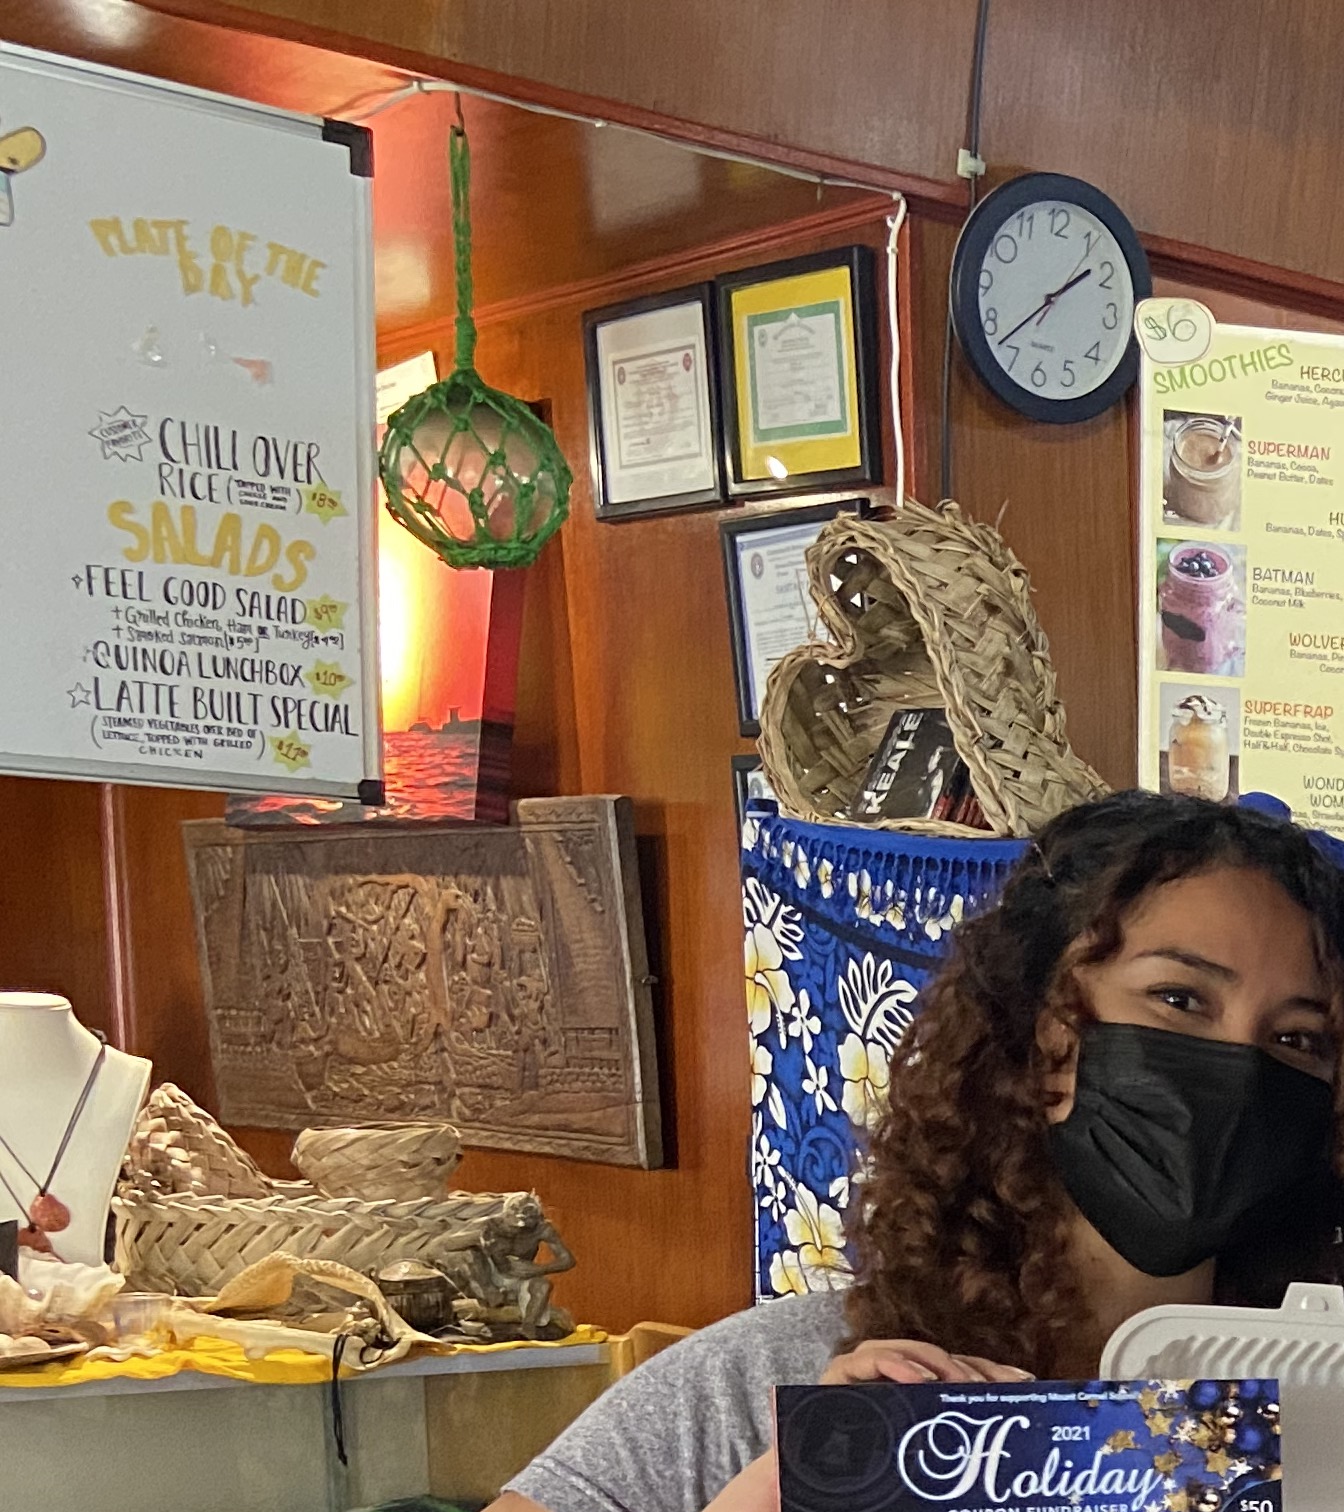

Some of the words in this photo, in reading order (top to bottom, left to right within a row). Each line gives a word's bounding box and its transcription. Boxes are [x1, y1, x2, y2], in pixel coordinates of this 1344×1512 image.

[1017, 211, 1034, 240] 11
[1049, 208, 1070, 239] 12
[1084, 231, 1092, 257] 1
[980, 269, 993, 297] 9
[1099, 261, 1114, 290] 2
[984, 307, 997, 336] 8
[1102, 302, 1117, 330] 3
[1144, 305, 1197, 342] $6
[1006, 345, 1020, 372] 7
[1084, 341, 1101, 366] 4
[1031, 361, 1046, 387] 6
[1060, 360, 1075, 387] 5
[1152, 343, 1294, 395] SMOOTHIES
[159, 417, 238, 471] CHILI
[253, 436, 328, 487] OVER
[1248, 440, 1331, 460] SUPERMAN
[158, 462, 221, 504] RICE
[107, 499, 317, 593] SALADS
[1253, 567, 1315, 585] BATMAN
[85, 564, 152, 602] FEEL
[163, 576, 226, 610] GOOD
[235, 587, 307, 625] SALAD
[92, 640, 192, 676] QUINOA
[198, 651, 305, 688] LUNCHBOX
[93, 676, 181, 719] LATTE
[193, 686, 263, 725] BUILT
[270, 695, 359, 737] SPECIAL
[1244, 700, 1334, 719] SUPERFRAP
[138, 745, 203, 759] CHICKEN
[968, 1395, 985, 1404] you
[1051, 1425, 1091, 1442] 2021
[898, 1410, 1163, 1510] Holiday
